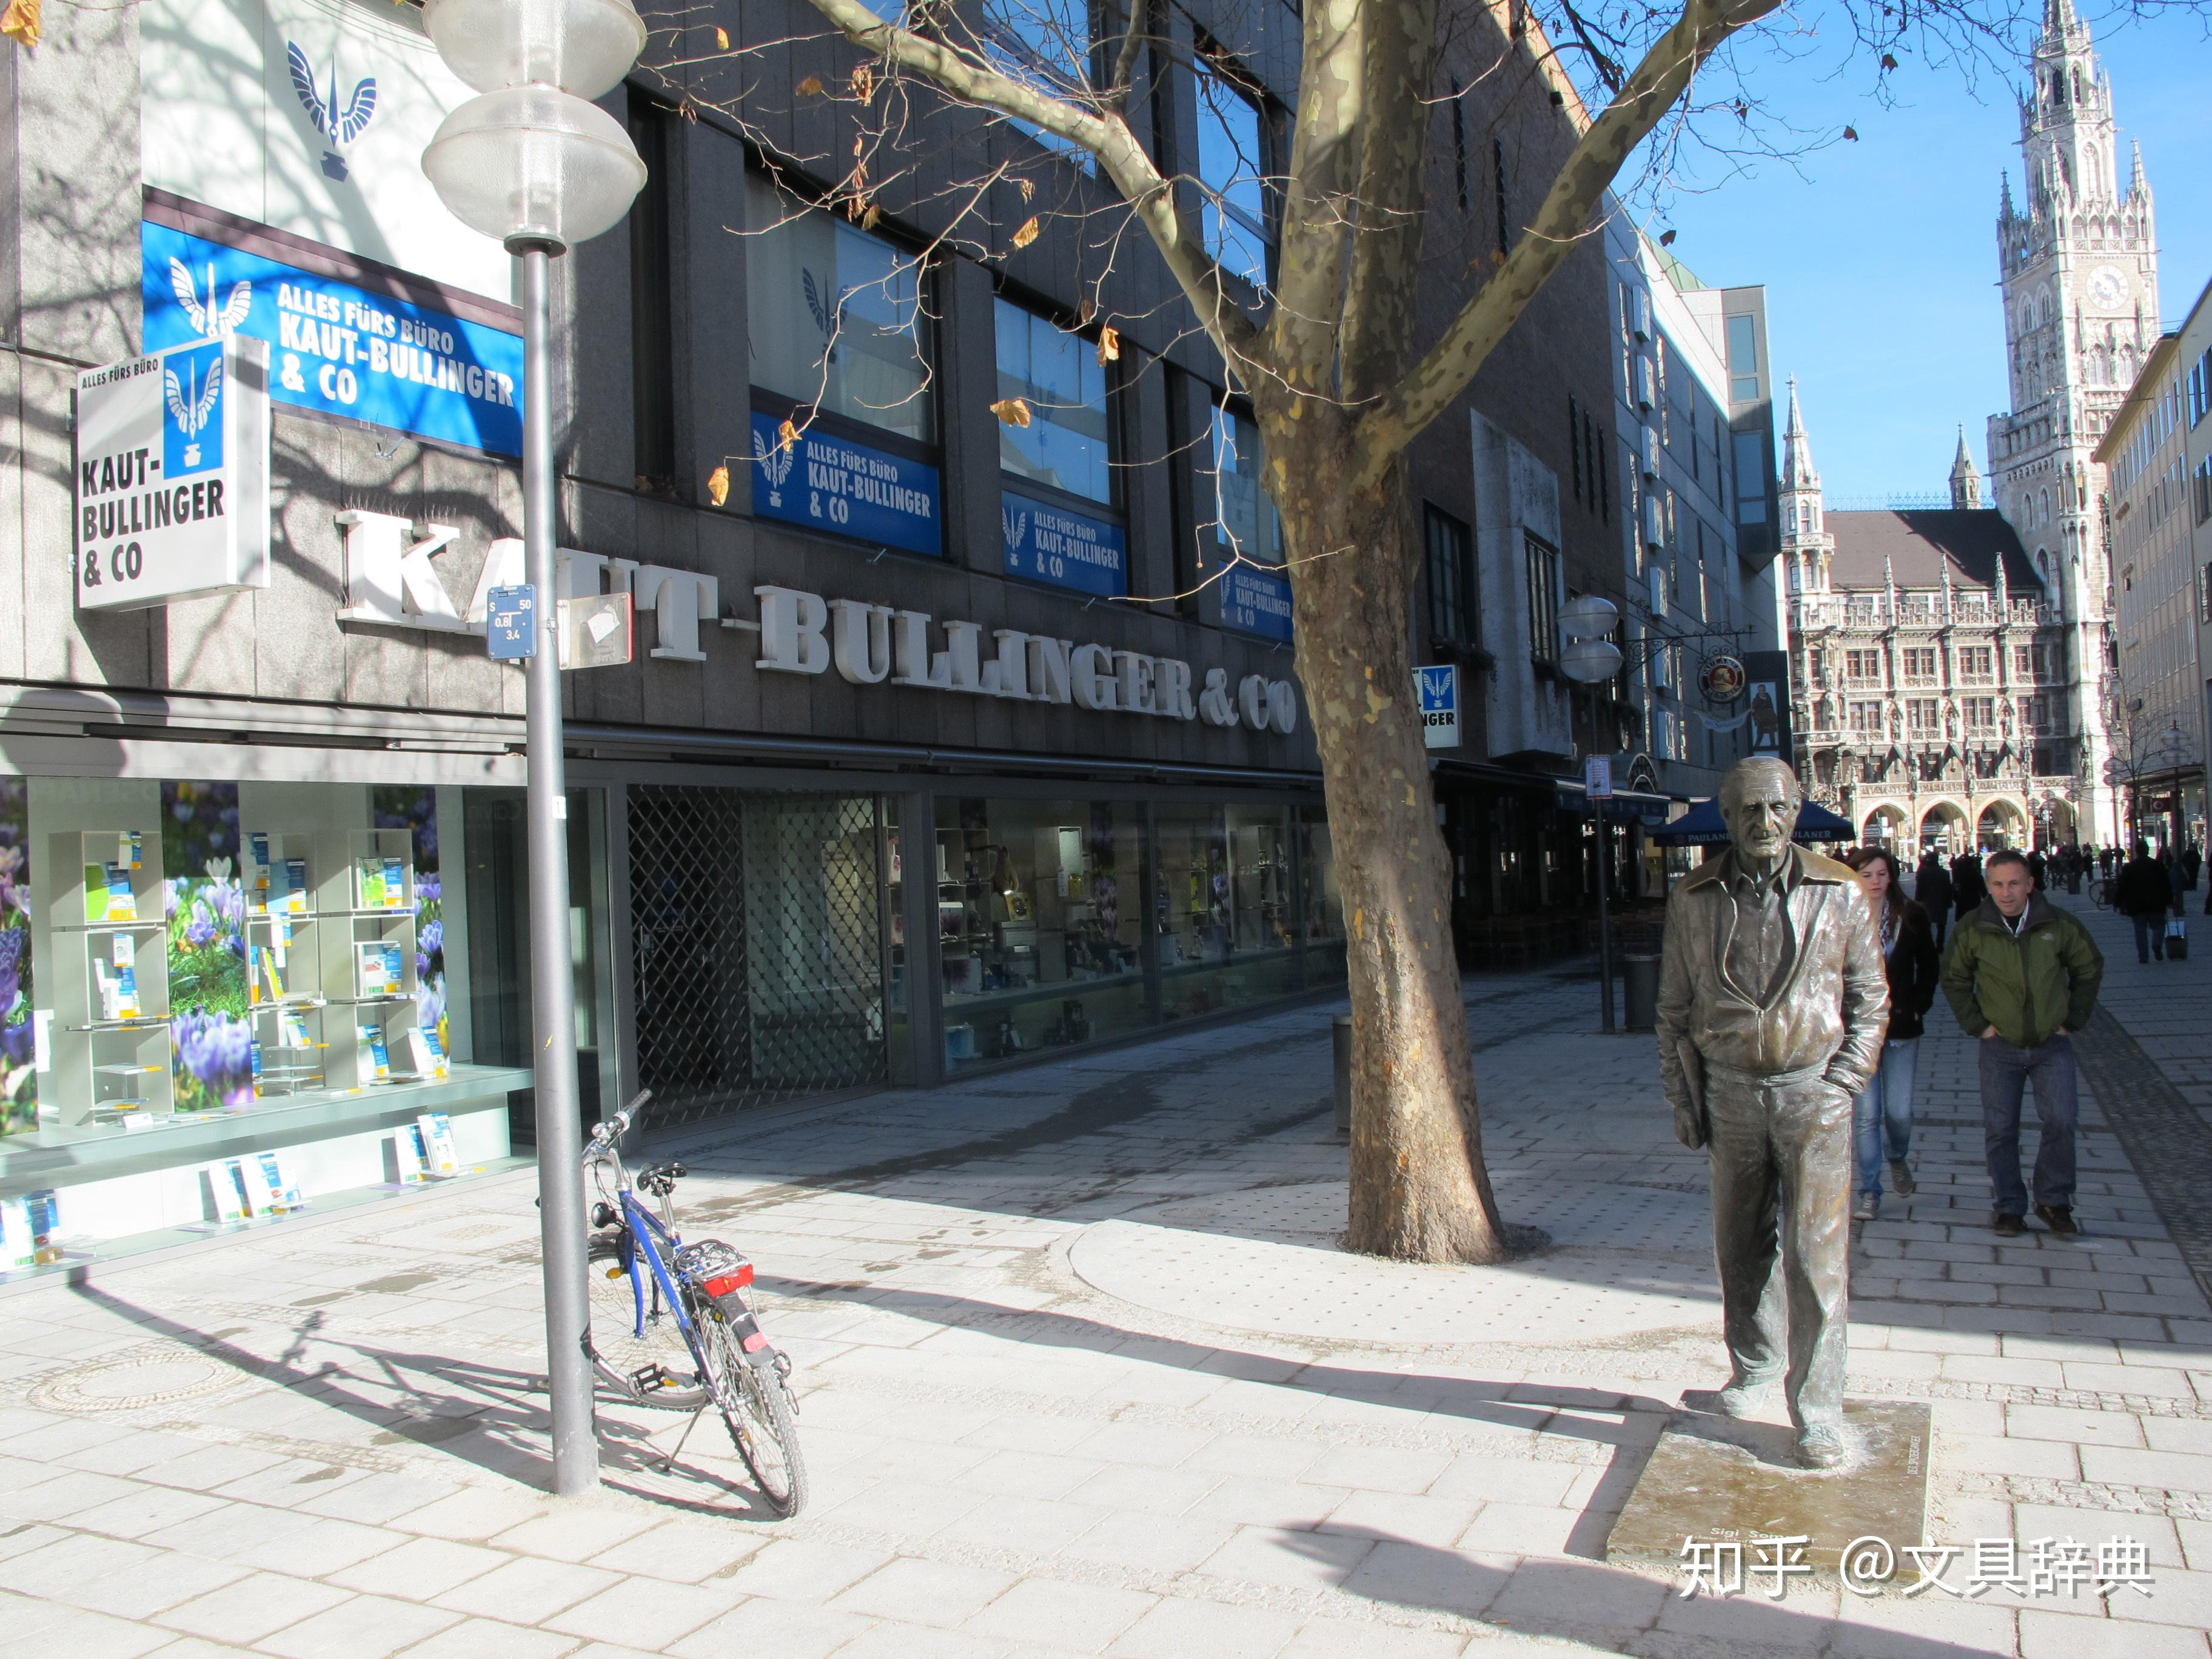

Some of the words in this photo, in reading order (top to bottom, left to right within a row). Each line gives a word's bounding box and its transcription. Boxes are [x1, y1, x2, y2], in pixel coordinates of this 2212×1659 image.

[277, 283, 341, 322] ALLES
[344, 301, 397, 339] FÜRS
[400, 318, 455, 355] BÜRO
[81, 376, 107, 390] ALLES
[109, 363, 131, 383] FÜRS
[134, 358, 159, 377] BÜRO
[279, 310, 514, 407] KAUT-BULLINGER
[281, 353, 306, 392] &
[319, 363, 358, 405] CO
[82, 447, 161, 498] KAUT-
[807, 441, 839, 466] ALLES
[841, 450, 868, 475] FÜRS
[869, 459, 898, 483] BÜRO
[808, 461, 931, 518] KAUT-BULLINGER
[810, 491, 823, 518] &
[829, 497, 849, 525] CO
[83, 479, 224, 543] BULLINGER
[1034, 511, 1056, 531] ALLES
[1057, 518, 1075, 537] FÜRS
[1076, 524, 1096, 542] BÜRO
[84, 550, 102, 588] &
[112, 541, 143, 582] CO
[1035, 528, 1119, 570] KAUT-BULLINGER
[1037, 552, 1046, 574] &
[1050, 555, 1063, 578] CO
[489, 602, 496, 612] S
[519, 599, 532, 610] 50
[1236, 586, 1291, 618] KAUT-BULLINGER
[1688, 833, 1731, 843] PAULANE
[1791, 830, 1831, 839] ULANER
[1711, 1527, 1740, 1538] Sigi
